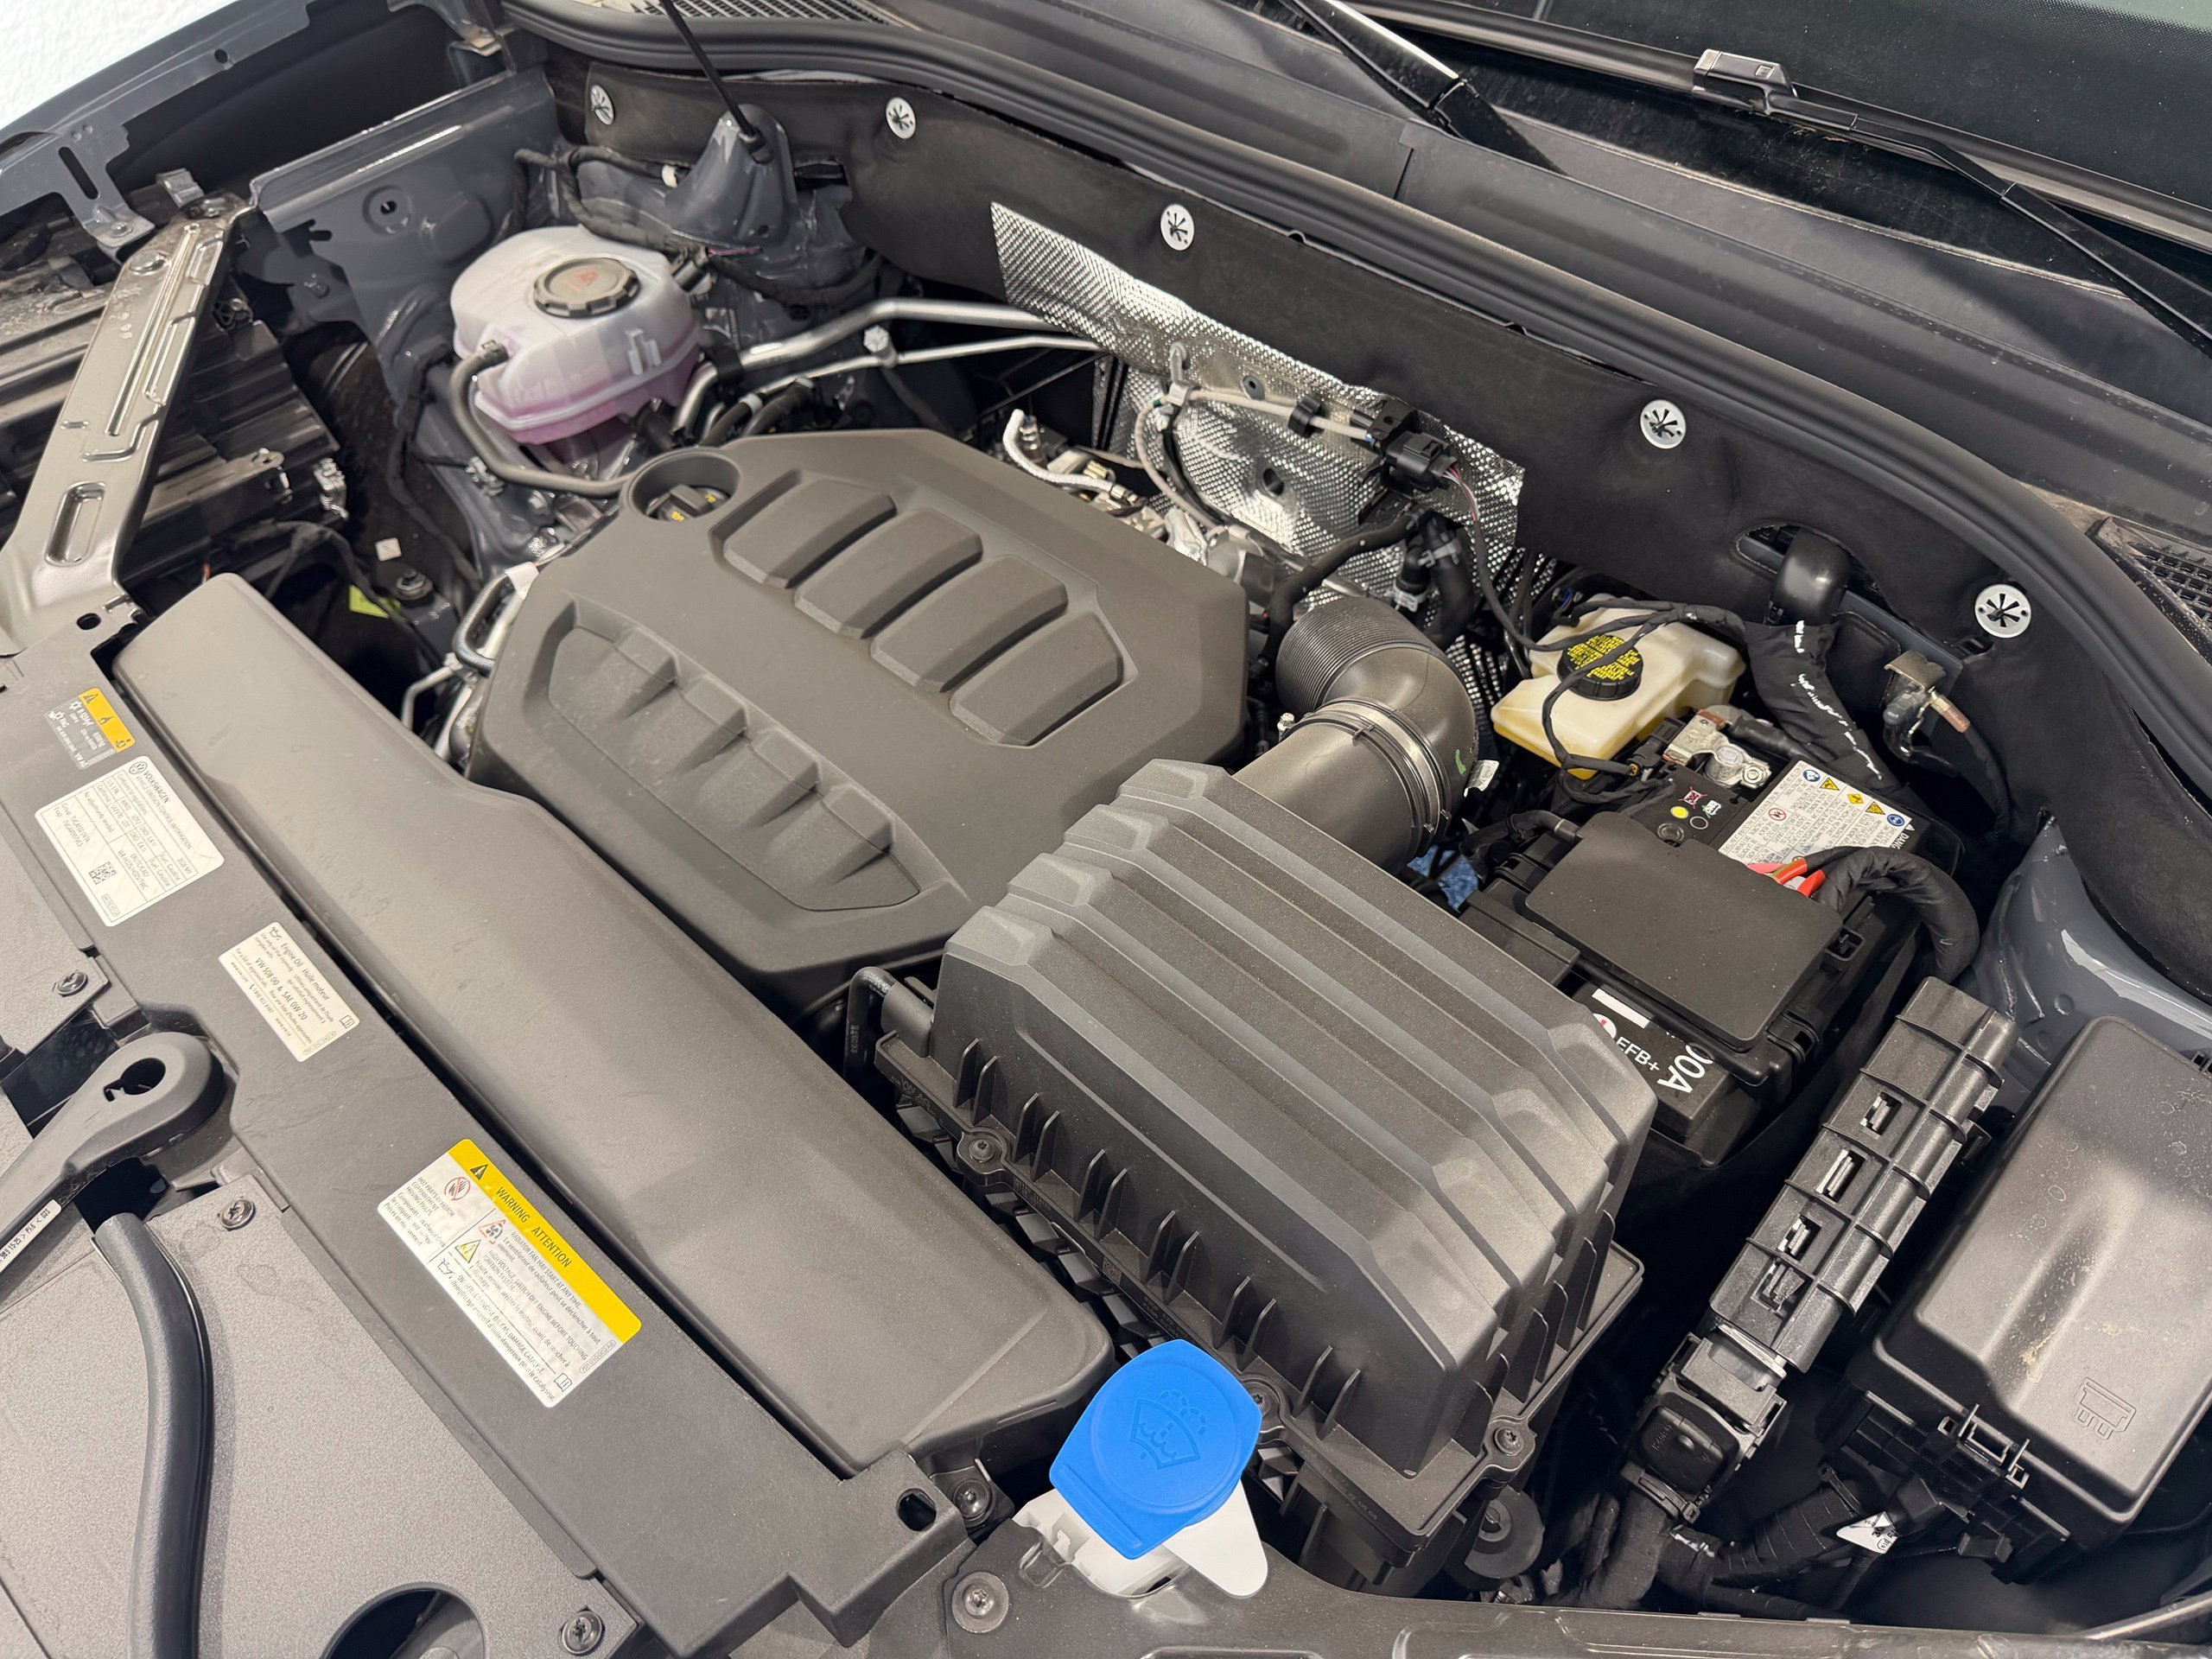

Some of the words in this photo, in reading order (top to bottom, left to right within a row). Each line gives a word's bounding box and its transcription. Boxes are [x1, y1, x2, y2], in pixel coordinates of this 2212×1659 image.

[142, 770, 171, 804] VOLKSWAGEN
[156, 805, 174, 824] CONTROL
[169, 822, 194, 850] INFORMATION
[277, 942, 298, 962] Engine
[292, 957, 304, 968] Oil
[253, 957, 267, 969] VW
[269, 976, 281, 986] 00
[280, 990, 294, 1003] SAE
[300, 967, 317, 983] Huile
[311, 980, 331, 1001] moteur
[1616, 1036, 1661, 1071] EFB+
[404, 1185, 423, 1204] MOVING
[416, 1176, 428, 1186] HOT
[423, 1184, 438, 1198] PARTS
[438, 1200, 455, 1217] MOTOR
[494, 1185, 531, 1224] WARNING
[530, 1224, 573, 1268] ATTENTION
[481, 1253, 501, 1274] IGNITION
[509, 1230, 531, 1253] RADIATOR
[527, 1249, 539, 1262] FAN
[535, 1259, 547, 1271] MAY
[543, 1268, 559, 1283] START
[560, 1286, 572, 1298] ANY
[568, 1294, 582, 1310] TIME.
[487, 1249, 501, 1262] HIGH
[513, 1278, 531, 1297] SWITCH
[527, 1294, 539, 1306] OFF
[535, 1302, 553, 1321] ENGINE
[549, 1318, 569, 1338] BEFORE
[564, 1335, 588, 1361] TOUCHING
[507, 1242, 531, 1267] ventilateur
[527, 1263, 537, 1273] de
[532, 1269, 554, 1292] radiateur
[548, 1289, 563, 1303] peut
[564, 1304, 590, 1331] déclencher
[588, 1331, 601, 1344] tout
[506, 1332, 526, 1353] DAMAGE
[499, 1336, 523, 1363] dangereux
[531, 1374, 557, 1403] catalyseur.
